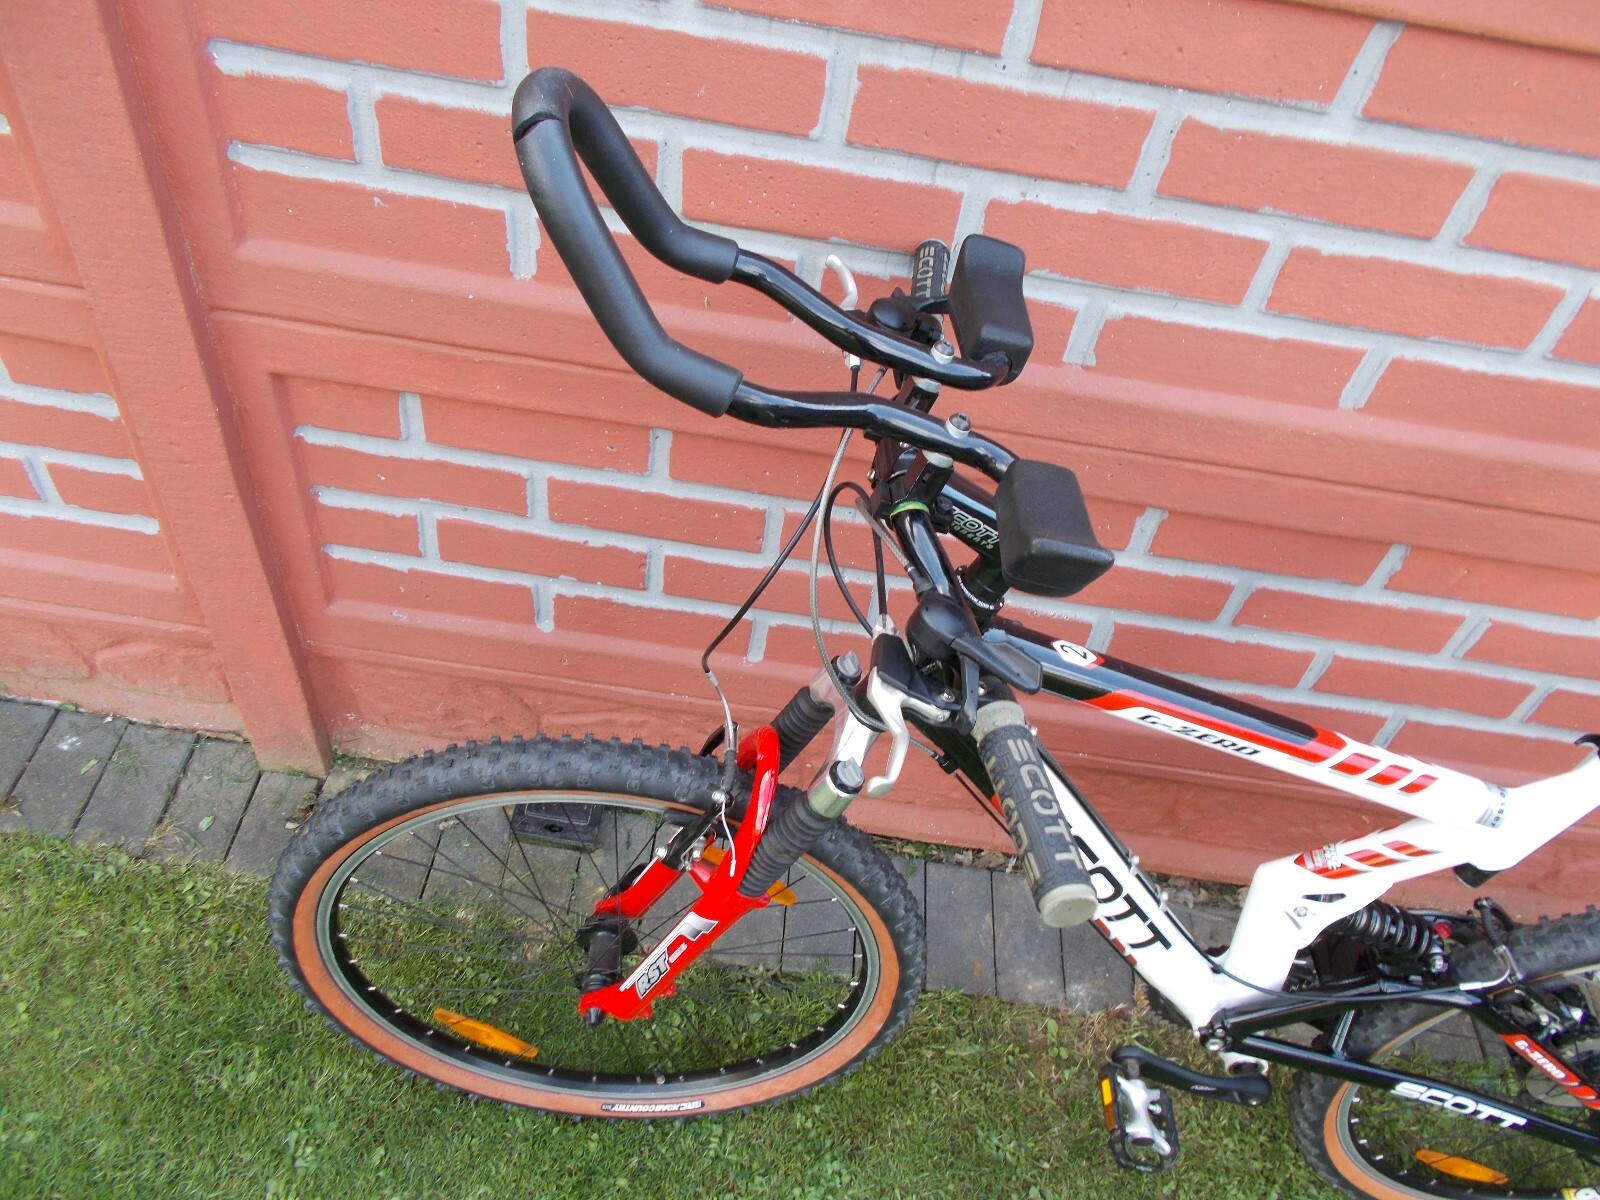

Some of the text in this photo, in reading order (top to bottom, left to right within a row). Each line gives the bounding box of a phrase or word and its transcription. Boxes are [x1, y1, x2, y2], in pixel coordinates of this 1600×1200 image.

[915, 246, 935, 298] SCOTT
[1137, 714, 1260, 756] G-ZERO
[1007, 738, 1083, 870] SCOTT
[636, 951, 668, 998] RST
[1389, 1081, 1529, 1130] SCOTT
